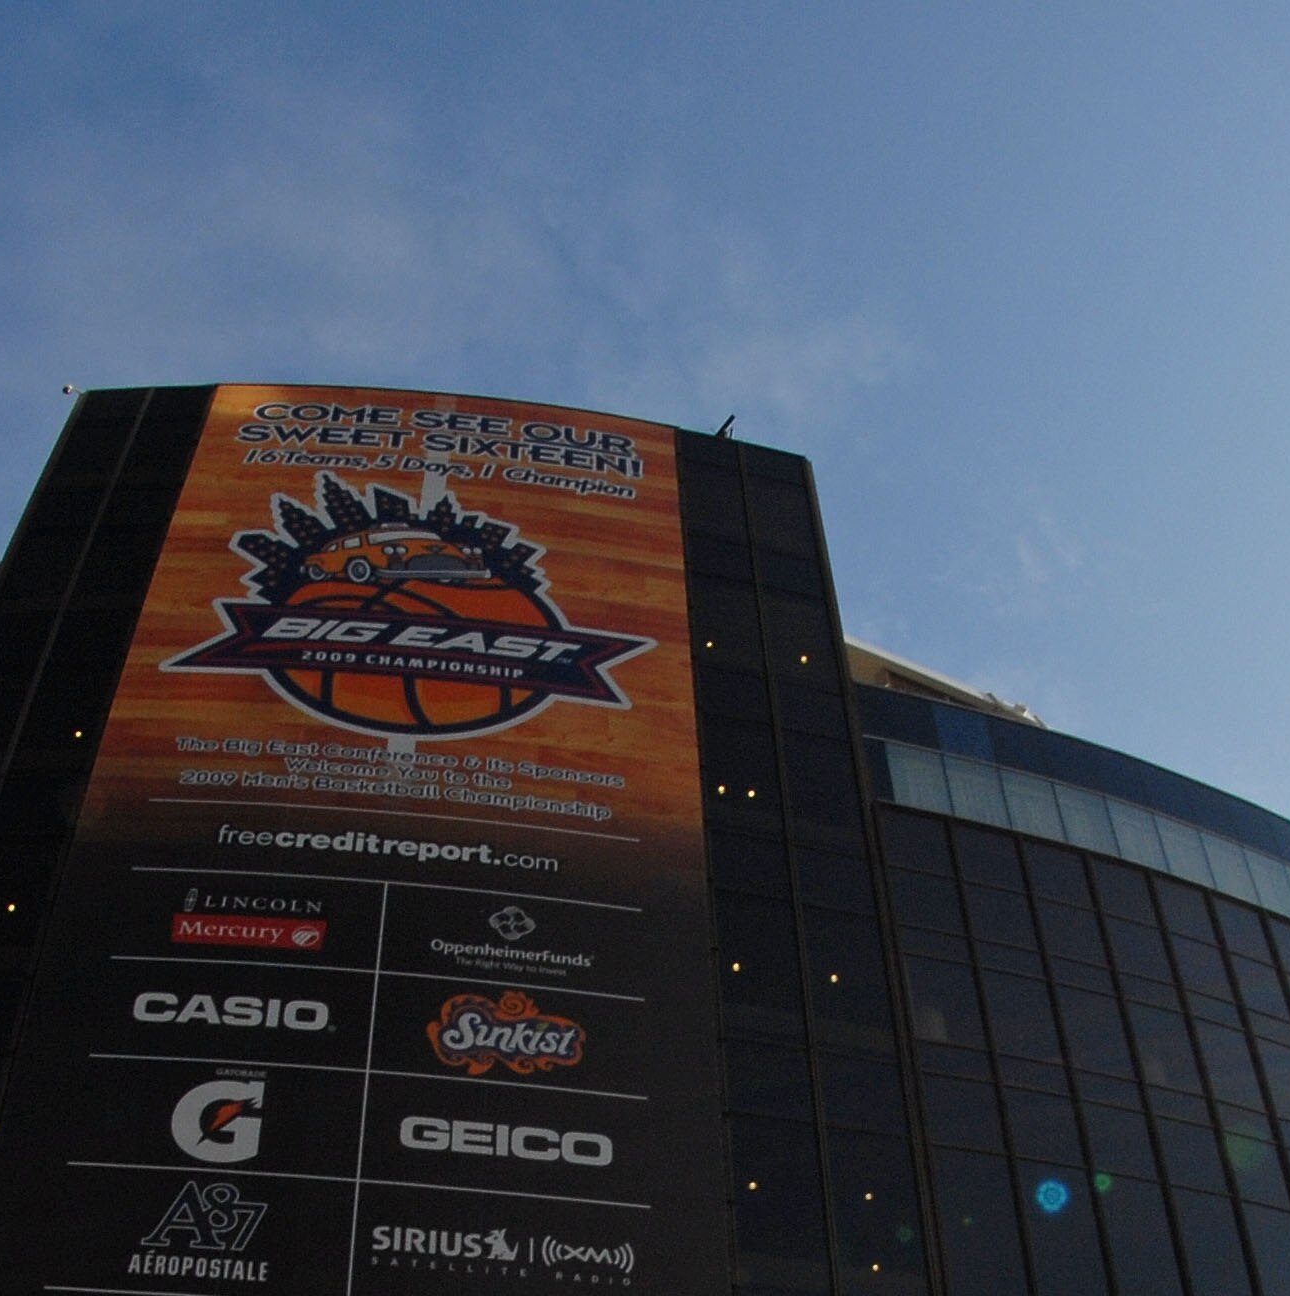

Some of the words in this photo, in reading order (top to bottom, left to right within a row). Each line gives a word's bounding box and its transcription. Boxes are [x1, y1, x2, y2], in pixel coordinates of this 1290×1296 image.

[239, 423, 412, 448] SWEET
[424, 433, 645, 478] SIXTEEN!
[255, 403, 400, 426] COME
[412, 410, 511, 436] SEE
[521, 422, 635, 456] OUR
[245, 448, 276, 464] 16
[276, 449, 369, 470] Teams,
[372, 454, 396, 470] 5
[401, 455, 472, 479] Days,
[478, 462, 495, 479] 1
[504, 467, 636, 498] Champion
[261, 617, 387, 643] BIG
[390, 626, 582, 663] EAST
[301, 649, 357, 665] 2009
[365, 654, 525, 680] CHAMPIONSHIP
[175, 736, 219, 753] The
[222, 738, 262, 757] Big
[266, 738, 317, 757] East
[320, 742, 459, 768] Conference
[486, 755, 514, 774] Its
[517, 759, 627, 789] Sponsors
[284, 756, 390, 779] Welcome
[396, 763, 439, 785] You
[444, 768, 469, 787] to
[472, 769, 513, 790] the
[179, 768, 238, 787] 2009
[242, 771, 310, 791] Men's
[314, 776, 441, 802] Basketball
[445, 786, 613, 822] Championship
[217, 824, 560, 873] freecreditreport.com
[204, 894, 323, 914] LINCOLN
[178, 919, 286, 944] Mercury
[430, 938, 593, 968] OppenheimerFunds
[132, 991, 329, 1031] CASIO
[442, 1012, 575, 1055] Sunkist
[171, 1079, 265, 1163] G
[400, 1115, 613, 1166] GEICO
[371, 1225, 483, 1259] SIRIUS
[127, 1250, 269, 1282] AÉROPOSTALE
[371, 1255, 528, 1278] SATELLITE
[555, 1272, 632, 1287] RADIO
